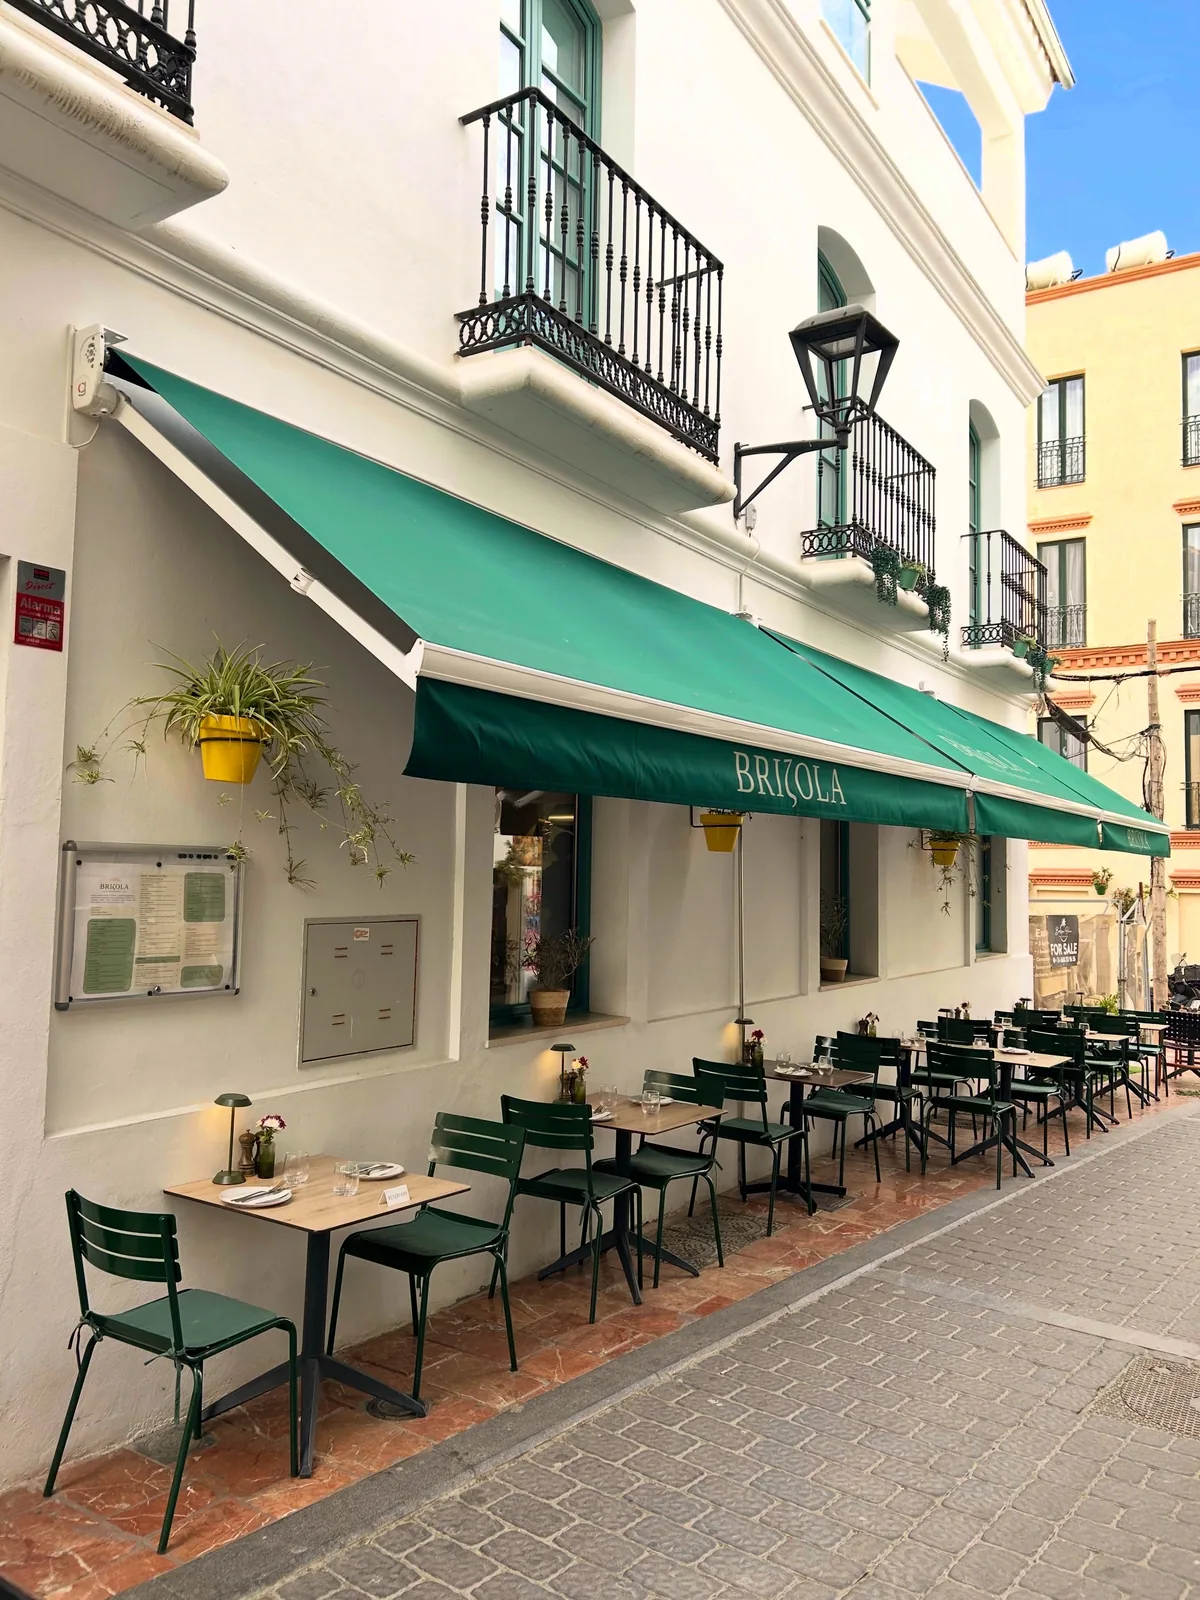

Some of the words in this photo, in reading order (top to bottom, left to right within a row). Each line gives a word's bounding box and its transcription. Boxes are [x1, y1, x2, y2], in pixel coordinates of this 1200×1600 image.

[20, 597, 61, 615] Alarma
[1050, 943, 1063, 956] FOR
[1063, 943, 1077, 955] SALE
